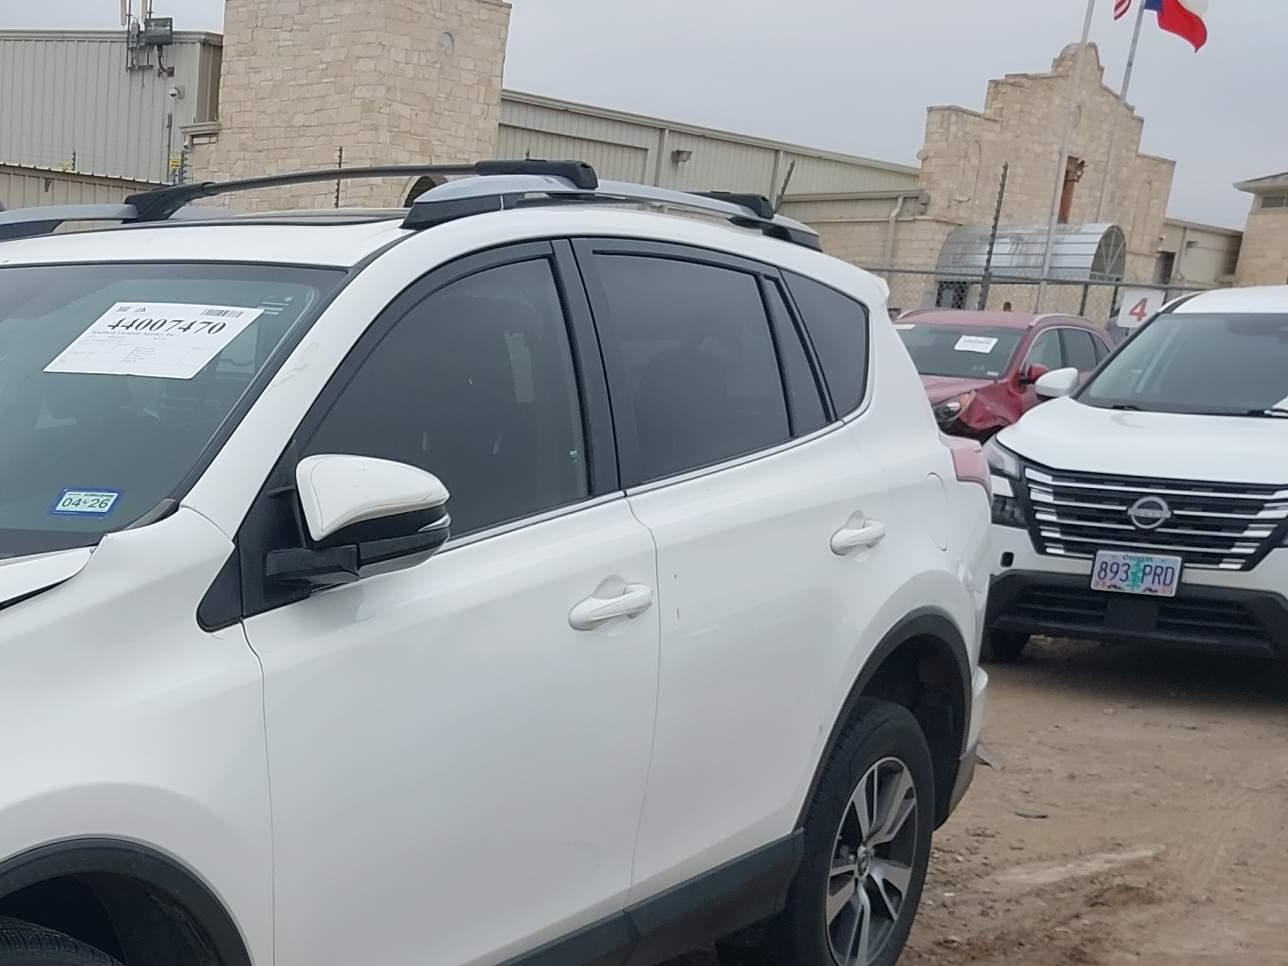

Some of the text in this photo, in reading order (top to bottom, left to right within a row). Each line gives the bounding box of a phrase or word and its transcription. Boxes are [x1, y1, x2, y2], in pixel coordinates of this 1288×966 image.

[1128, 297, 1148, 322] 4
[106, 316, 227, 336] 44007470
[61, 497, 111, 509] 04 26
[1097, 561, 1131, 582] 893
